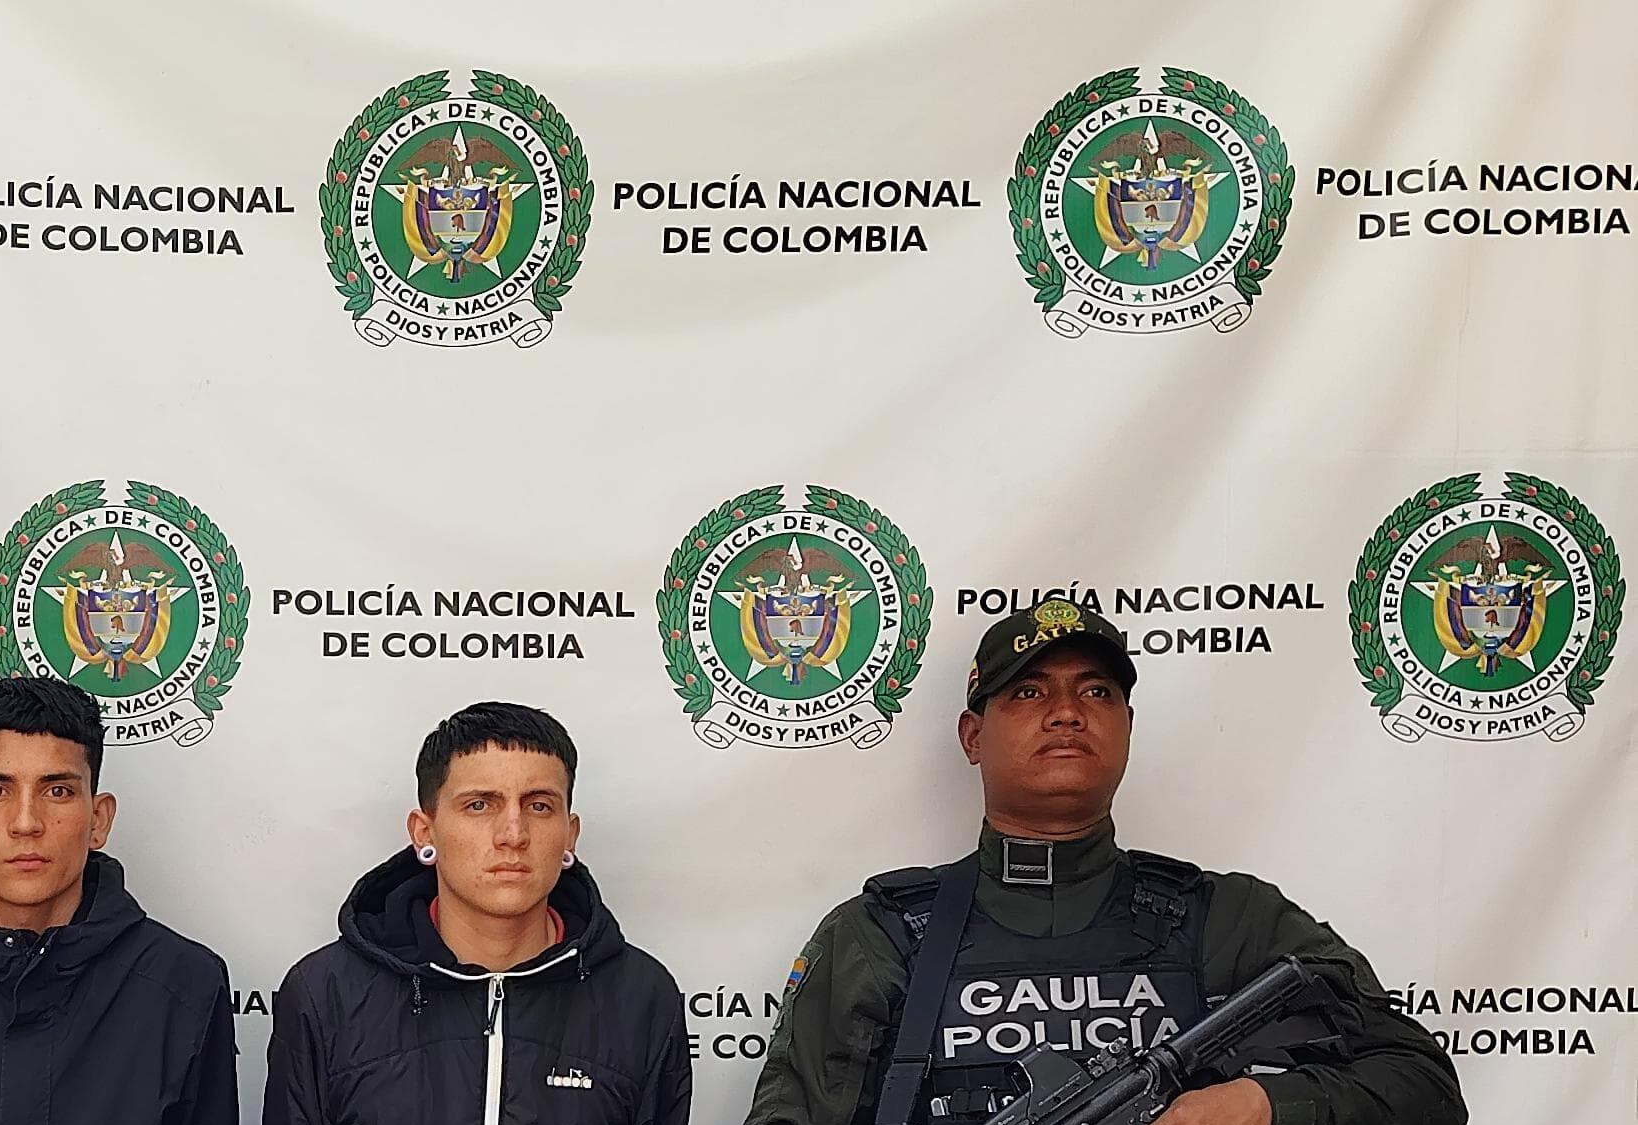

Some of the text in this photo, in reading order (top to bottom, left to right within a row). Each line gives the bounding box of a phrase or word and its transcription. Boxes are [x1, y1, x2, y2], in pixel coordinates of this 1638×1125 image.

[448, 103, 477, 119] DE
[499, 116, 558, 226] COLOMBIA
[1139, 98, 1169, 114] DE
[1192, 108, 1256, 211] COLOMBIA
[614, 174, 980, 209] POLICÍA NACIONAL
[1317, 160, 1638, 196] POLICÍA NACION
[95, 184, 294, 213] NACIONAL
[42, 225, 243, 255] COLOMBIA
[663, 226, 927, 253] DE COLOMBIA
[1359, 208, 1630, 239] DE COLOMBIA
[454, 251, 548, 316] NACIONAL
[1151, 235, 1248, 303] NACIONAL
[454, 311, 523, 341] PATRIA
[1151, 296, 1224, 327] PATRIA
[105, 510, 133, 526] DE
[155, 523, 215, 628] COLOMBIA
[784, 515, 812, 530] DE
[834, 527, 896, 631] COLOMBIA
[1481, 504, 1510, 519] DE
[1532, 516, 1591, 621] COLOMBIA
[274, 584, 634, 617] POLICÍA NACIONAL
[1116, 584, 1324, 614] NACIONAL
[324, 632, 584, 658] DE COLOMBIA
[1123, 629, 1272, 655] LOMBIA
[116, 652, 207, 714] NACIONAL
[794, 654, 888, 718] NACIONAL
[1487, 645, 1582, 710] NACIONAL
[117, 710, 184, 738] PATRIA
[795, 713, 864, 741] PATRIA
[1487, 704, 1557, 734] PATRIA
[961, 975, 1164, 1016] GAULA
